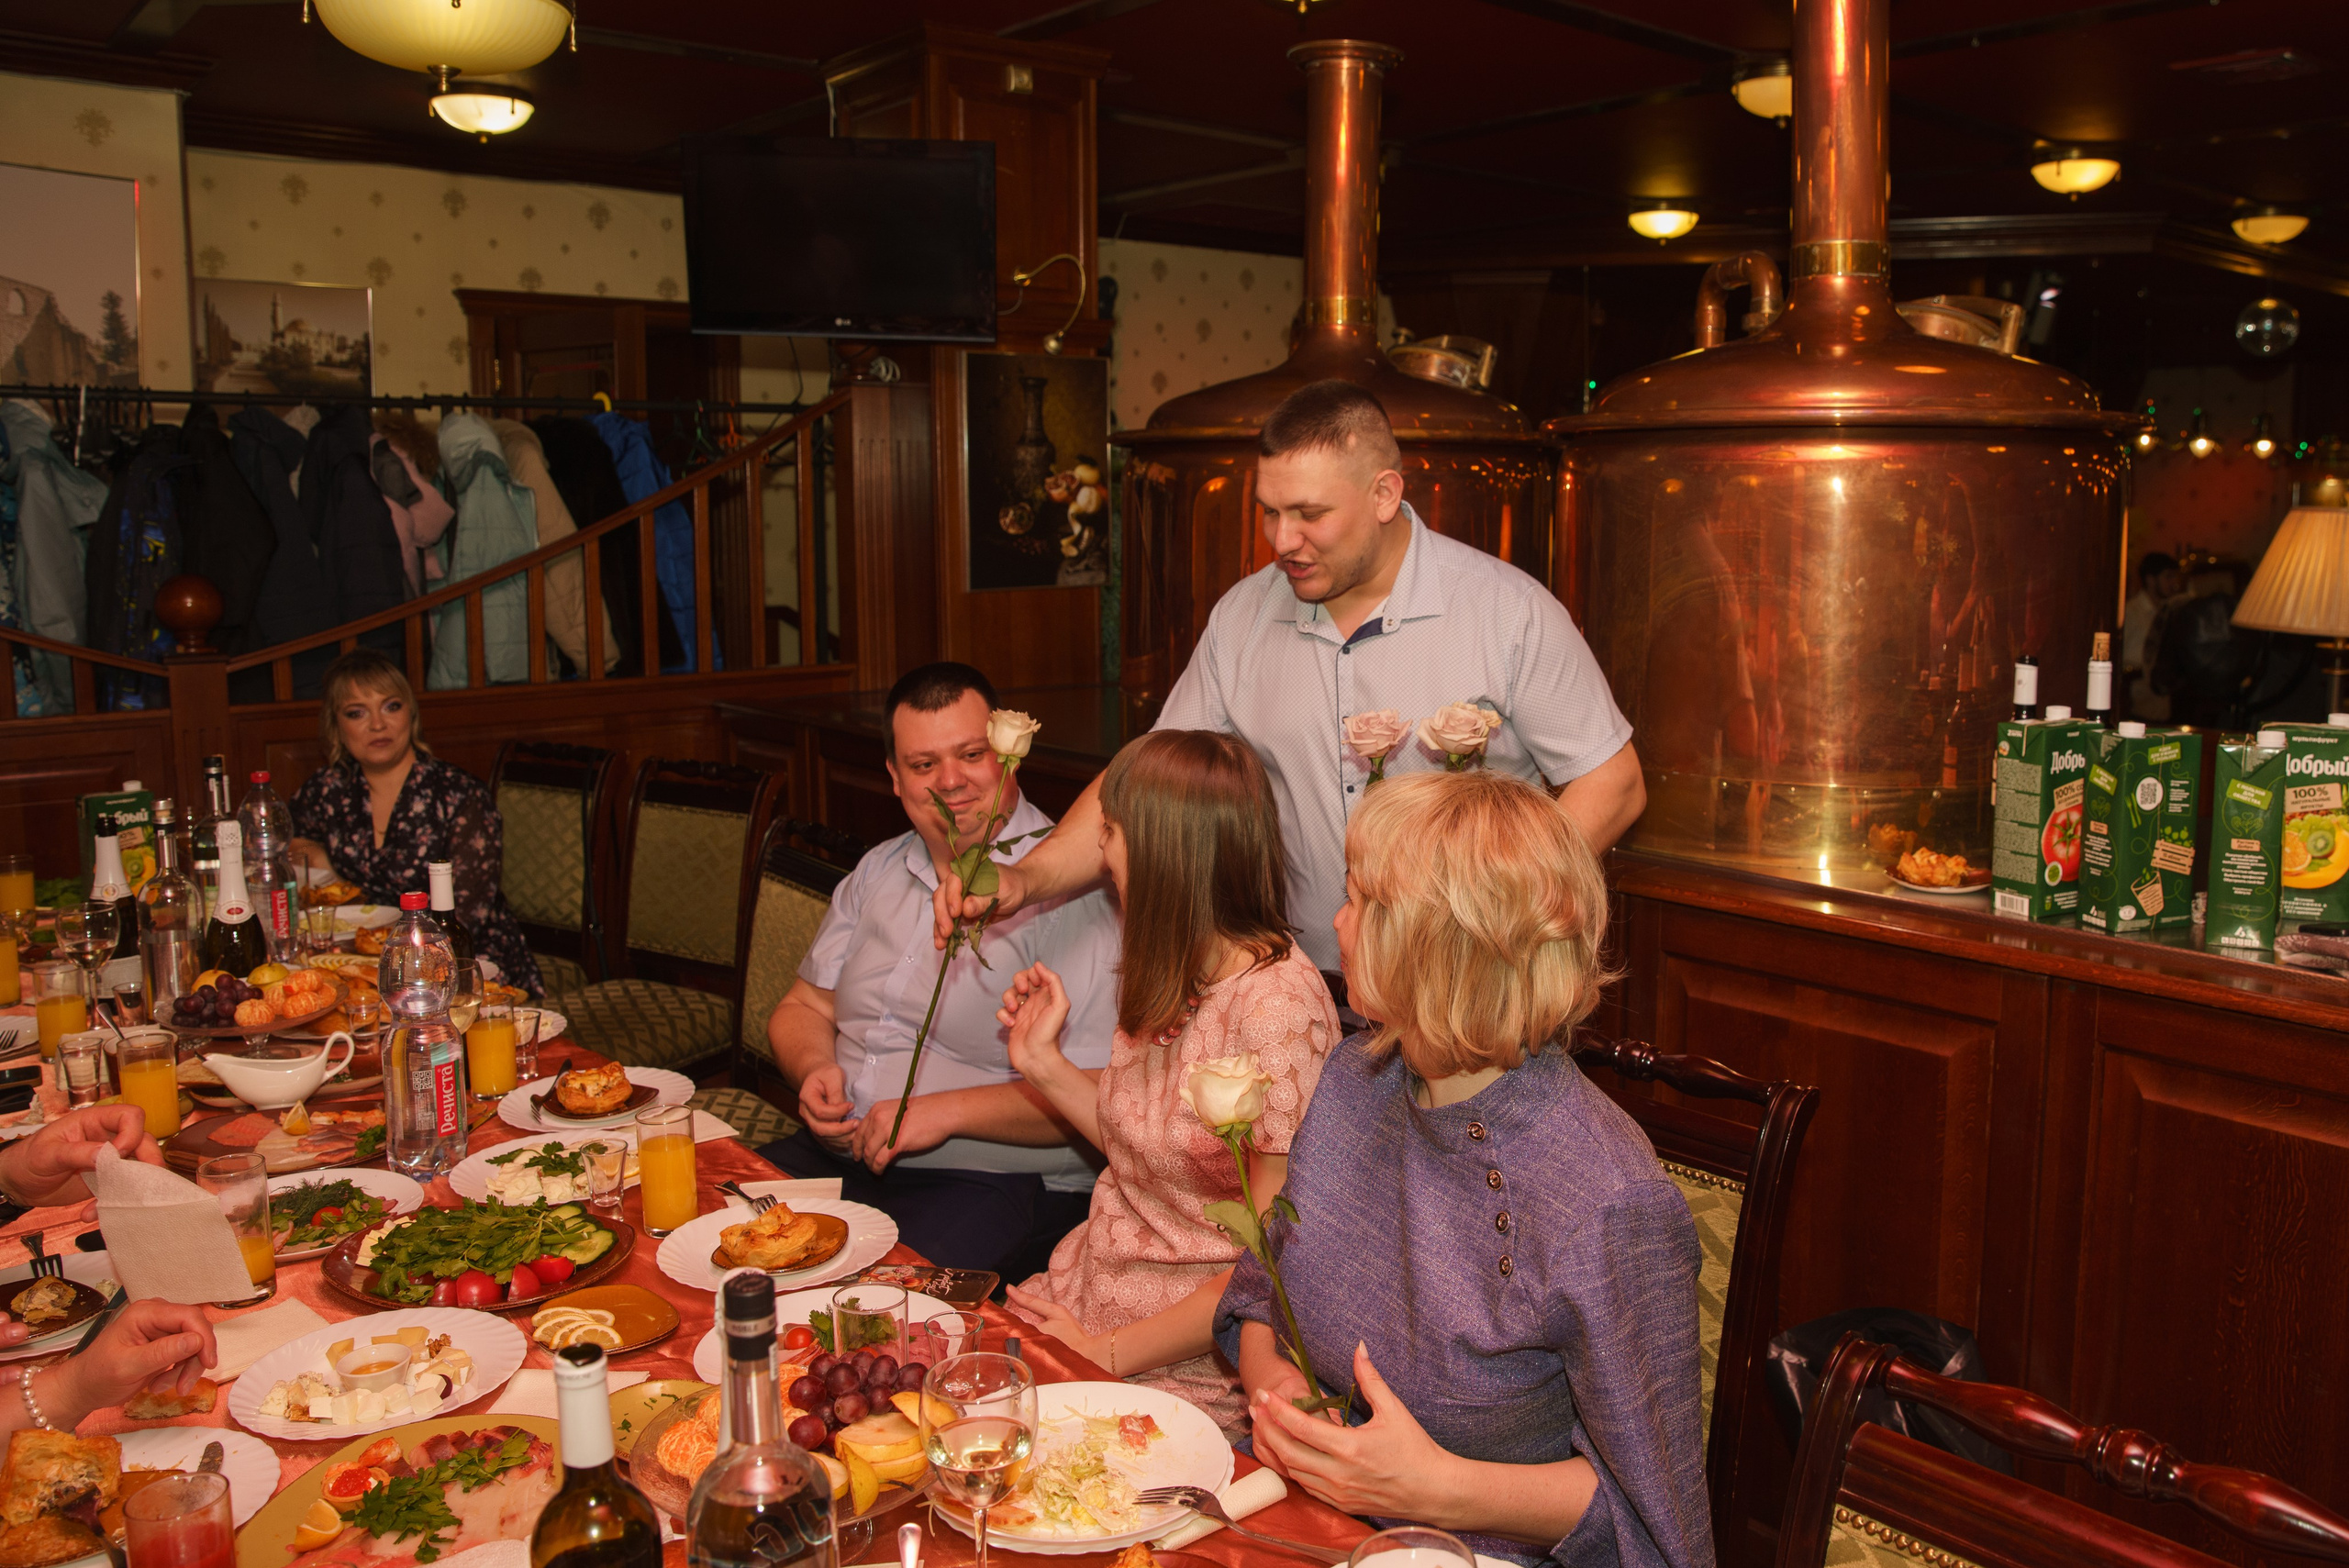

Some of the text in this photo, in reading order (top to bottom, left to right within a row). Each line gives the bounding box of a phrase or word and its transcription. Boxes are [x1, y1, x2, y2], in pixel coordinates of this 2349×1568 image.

[2055, 784, 2076, 799] 100%
[2293, 786, 2329, 799] 100%
[440, 1064, 456, 1134] Речиста
